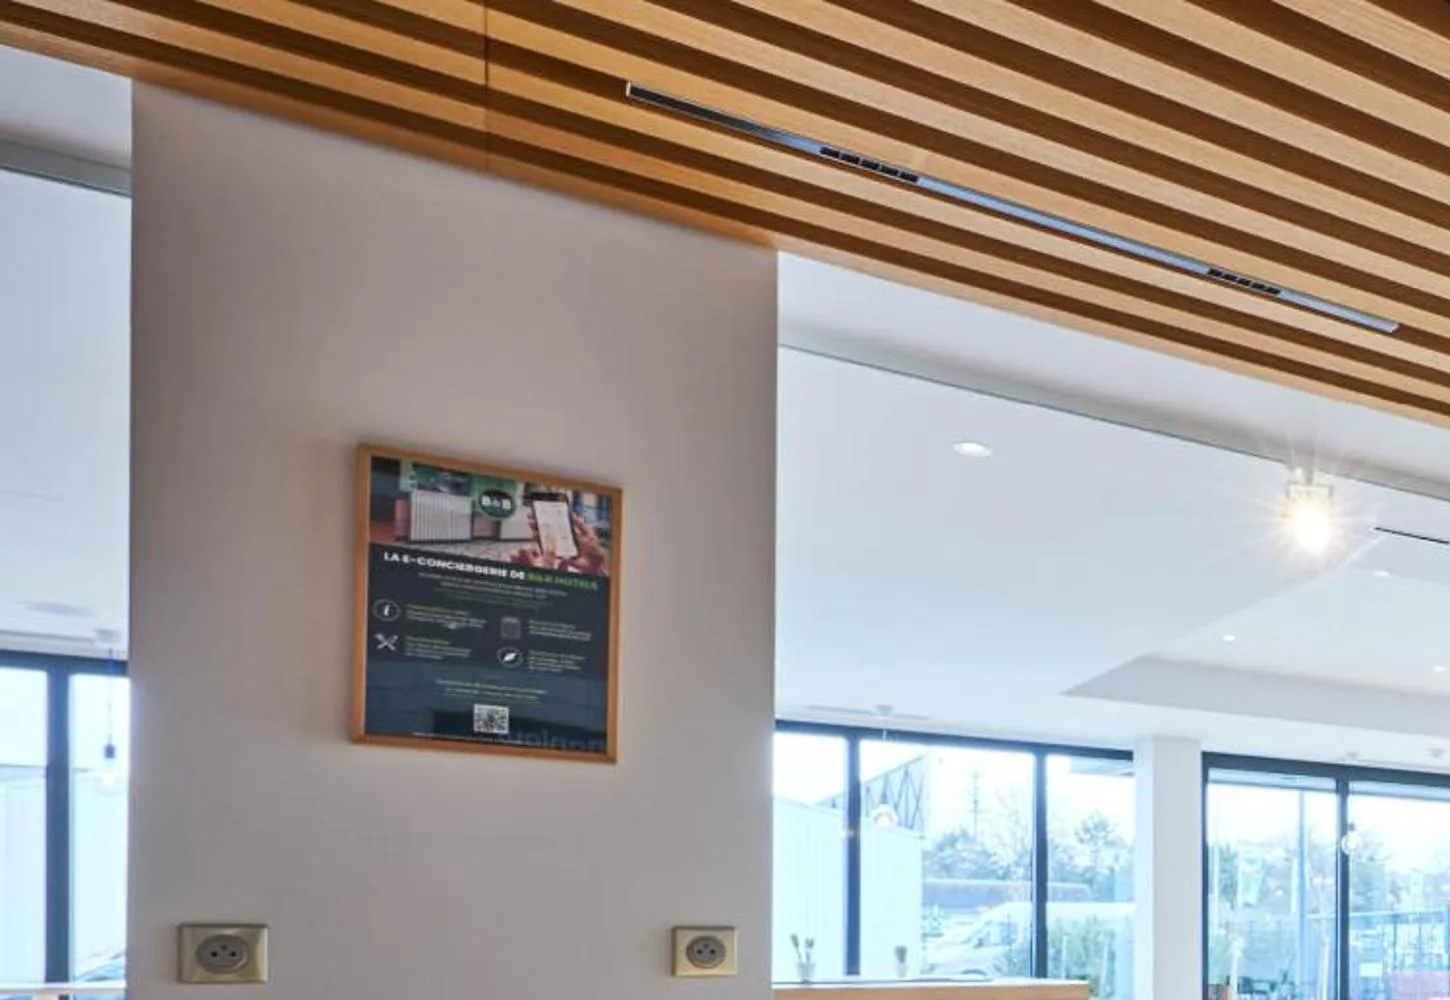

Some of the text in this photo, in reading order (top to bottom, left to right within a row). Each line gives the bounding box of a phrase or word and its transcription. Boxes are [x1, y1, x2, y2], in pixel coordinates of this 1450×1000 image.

[384, 552, 399, 562] LA
[402, 553, 508, 578] E-CONCIERGERIE
[509, 569, 525, 580] DE
